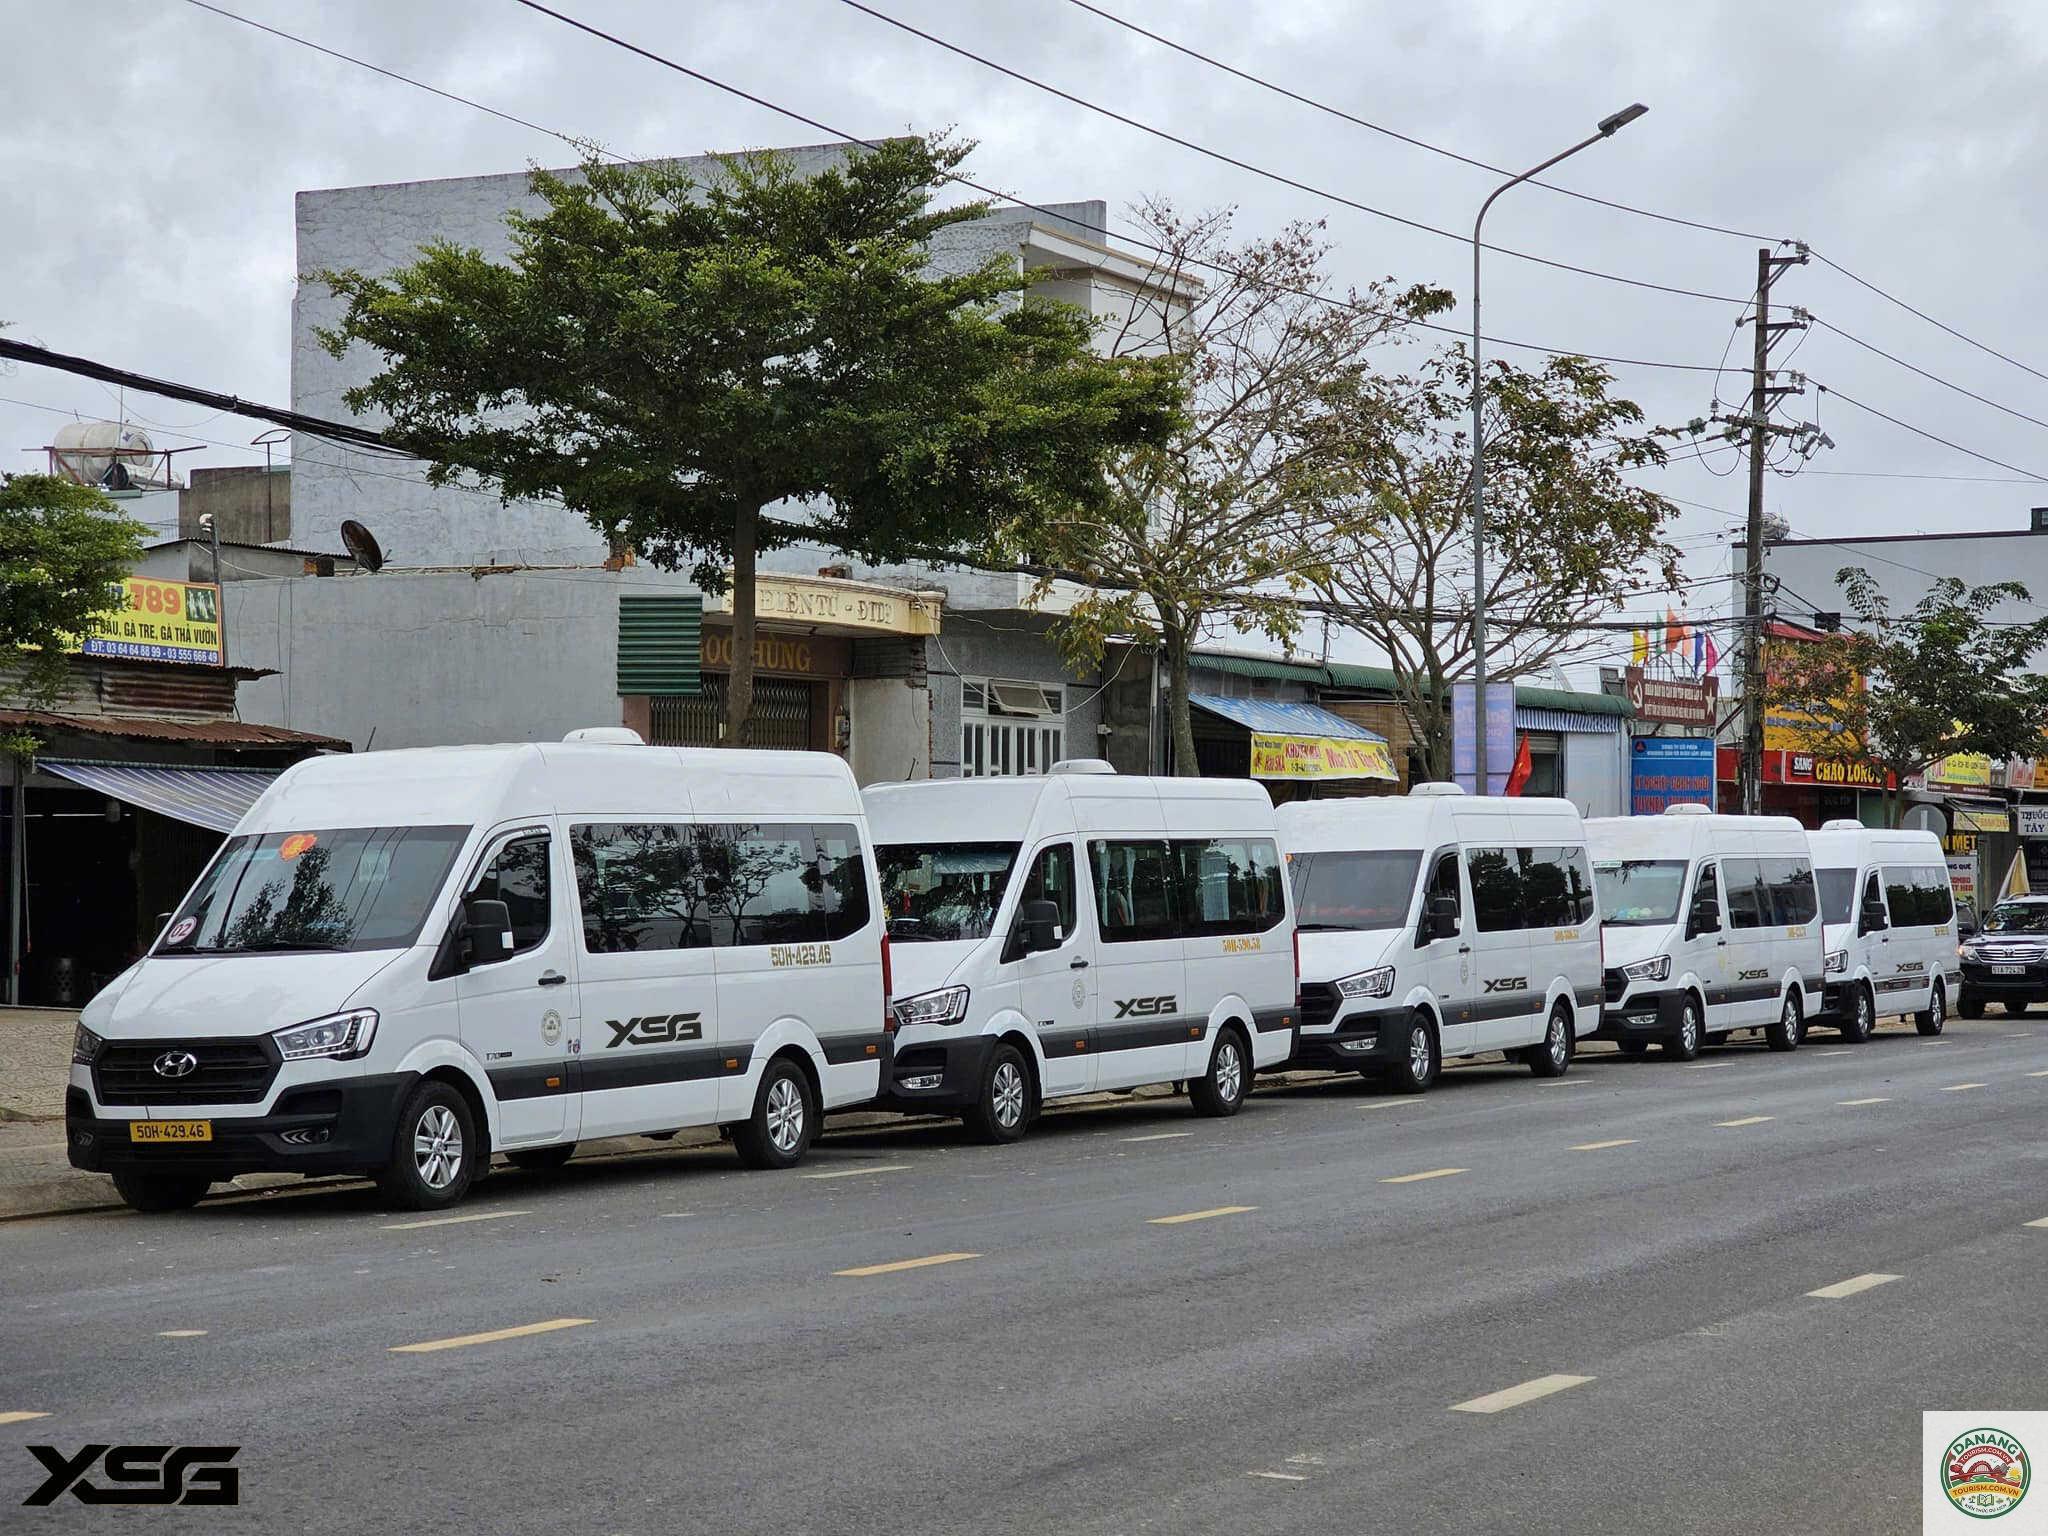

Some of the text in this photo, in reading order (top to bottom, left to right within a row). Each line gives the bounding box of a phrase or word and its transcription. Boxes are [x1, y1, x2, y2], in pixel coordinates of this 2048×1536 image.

[130, 583, 181, 615] 789
[124, 619, 136, 637] GÀ
[138, 623, 158, 640] TRE,
[160, 622, 172, 641] GÀ
[106, 642, 117, 653] 03
[118, 643, 128, 655] 64
[170, 922, 193, 938] 02
[770, 943, 832, 967] 50H-429.46
[1738, 968, 1769, 981] XSG
[1896, 961, 1925, 973] XSG
[1483, 976, 1528, 994] XSG
[1113, 994, 1178, 1019] XSG
[604, 1011, 703, 1048] XSG
[136, 1125, 205, 1138] 50H-429.46
